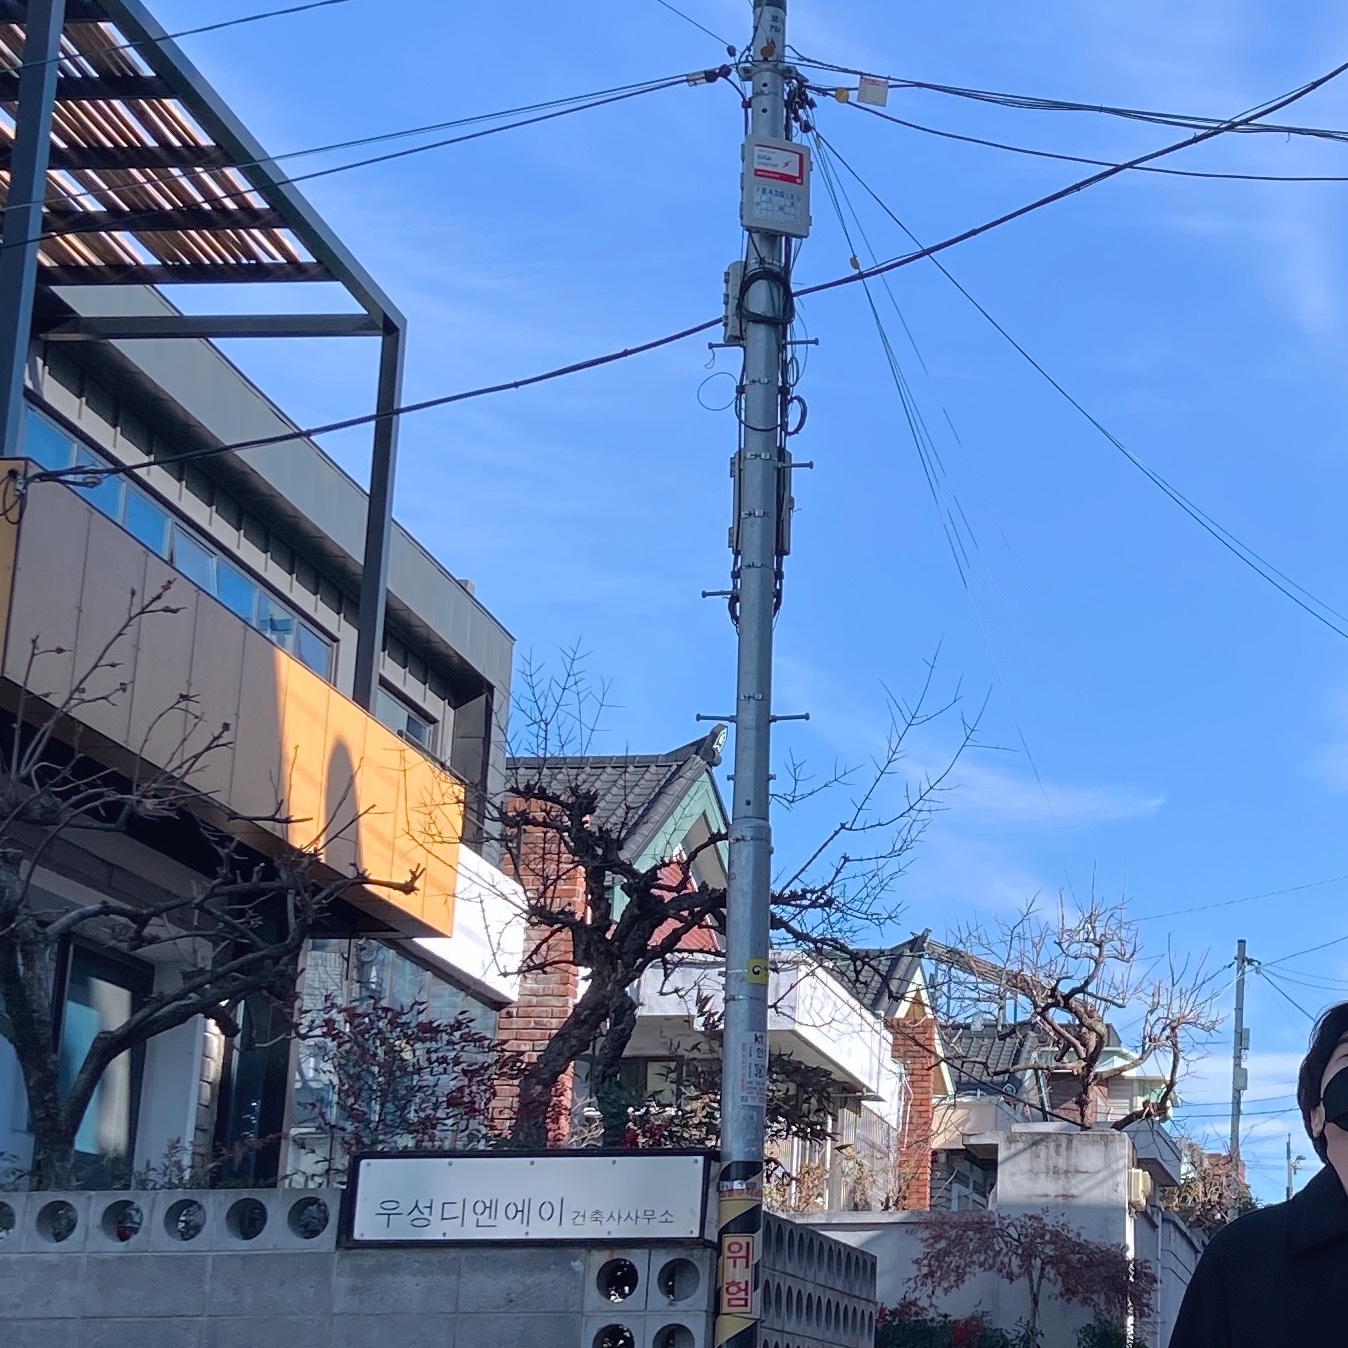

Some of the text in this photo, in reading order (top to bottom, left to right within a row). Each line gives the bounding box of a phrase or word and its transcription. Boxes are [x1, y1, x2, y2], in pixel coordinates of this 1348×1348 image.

[754, 1033, 764, 1044] kt
[375, 1196, 675, 1228] 우성디엔에이 건축사사무소
[725, 1241, 750, 1307] 위험
